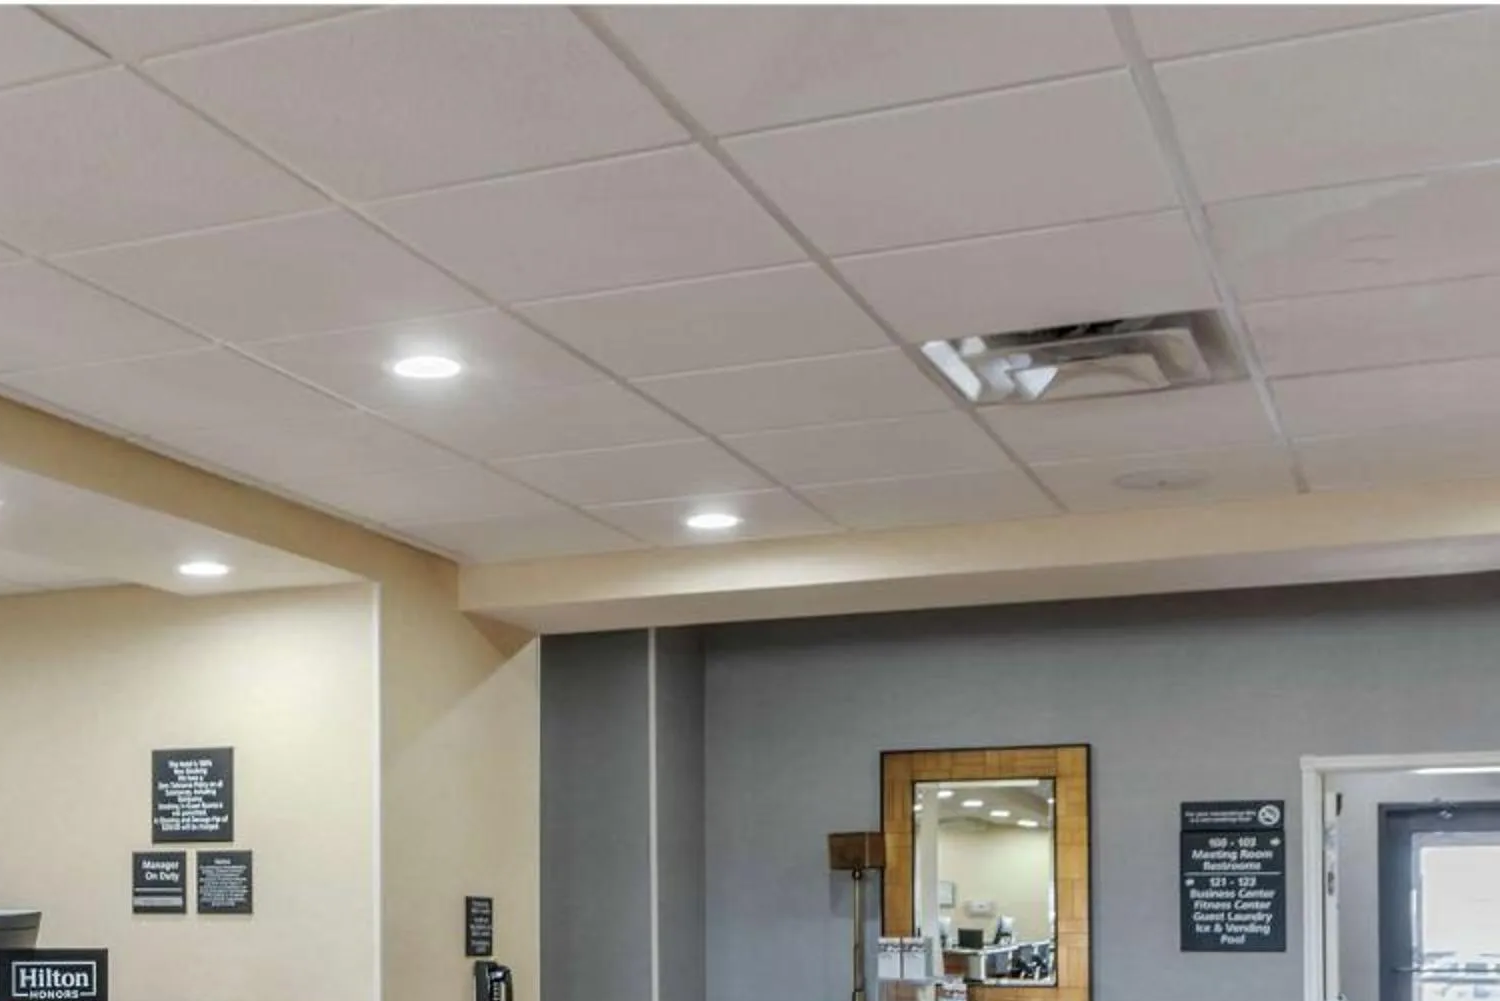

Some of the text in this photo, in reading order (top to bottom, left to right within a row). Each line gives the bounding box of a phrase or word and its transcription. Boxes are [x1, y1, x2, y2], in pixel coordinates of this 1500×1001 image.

[1192, 850, 1273, 861] Meeting Room
[141, 860, 179, 871] Manager
[145, 872, 180, 882] On Duty
[1189, 889, 1276, 899] Business Center
[1193, 900, 1272, 910] Fitness Center
[1193, 912, 1273, 923] Guest Laundry
[1195, 924, 1211, 933] Ice
[1225, 923, 1271, 935] Vending
[1220, 935, 1246, 944] Pool
[19, 967, 89, 988] Hilton
[29, 989, 79, 999] HONORS
